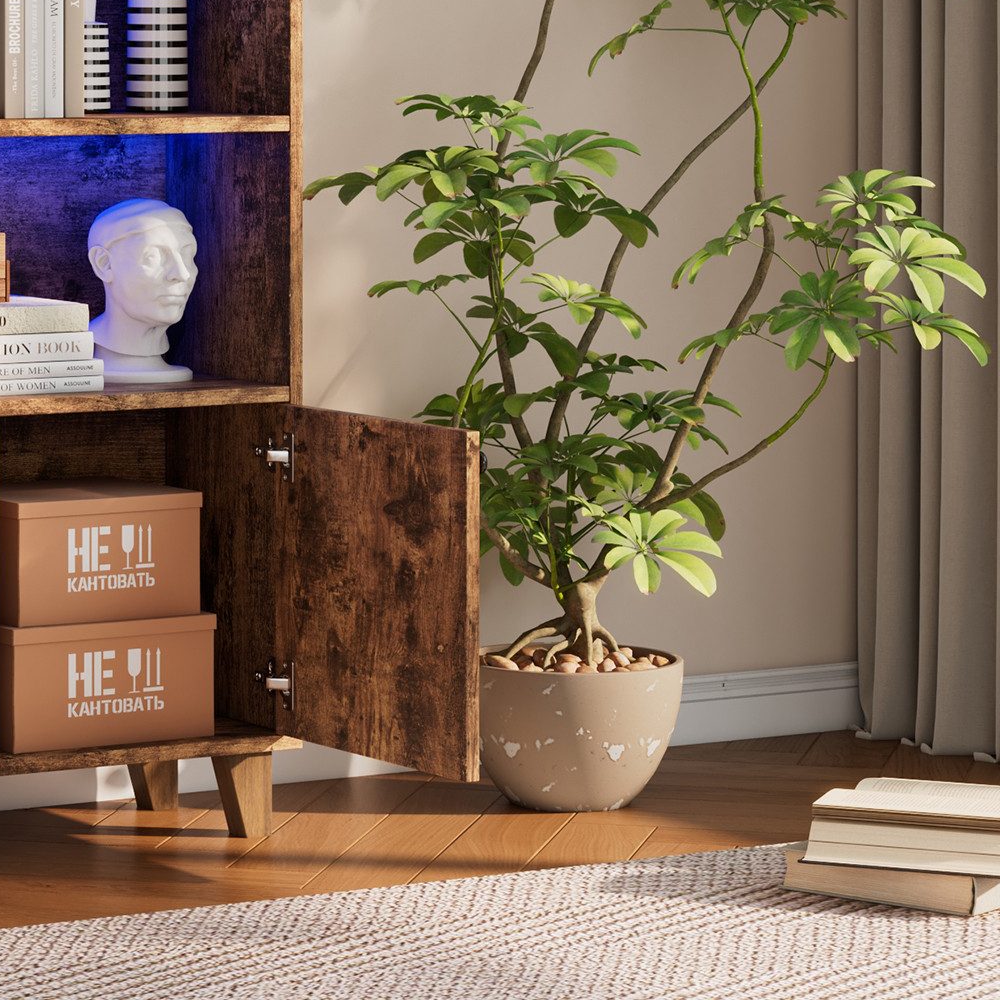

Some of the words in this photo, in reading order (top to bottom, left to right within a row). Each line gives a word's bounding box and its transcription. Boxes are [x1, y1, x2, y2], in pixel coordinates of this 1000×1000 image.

[37, 340, 81, 354] BOOK
[12, 368, 24, 376] OF
[28, 366, 51, 375] MEN
[0, 384, 12, 392] OF
[16, 382, 56, 391] WOMEN
[67, 526, 112, 574] НЕ
[67, 572, 156, 593] КАНТОВАТЬ
[67, 650, 116, 699] НЕ
[67, 696, 165, 718] КАНТОВАТЬ
